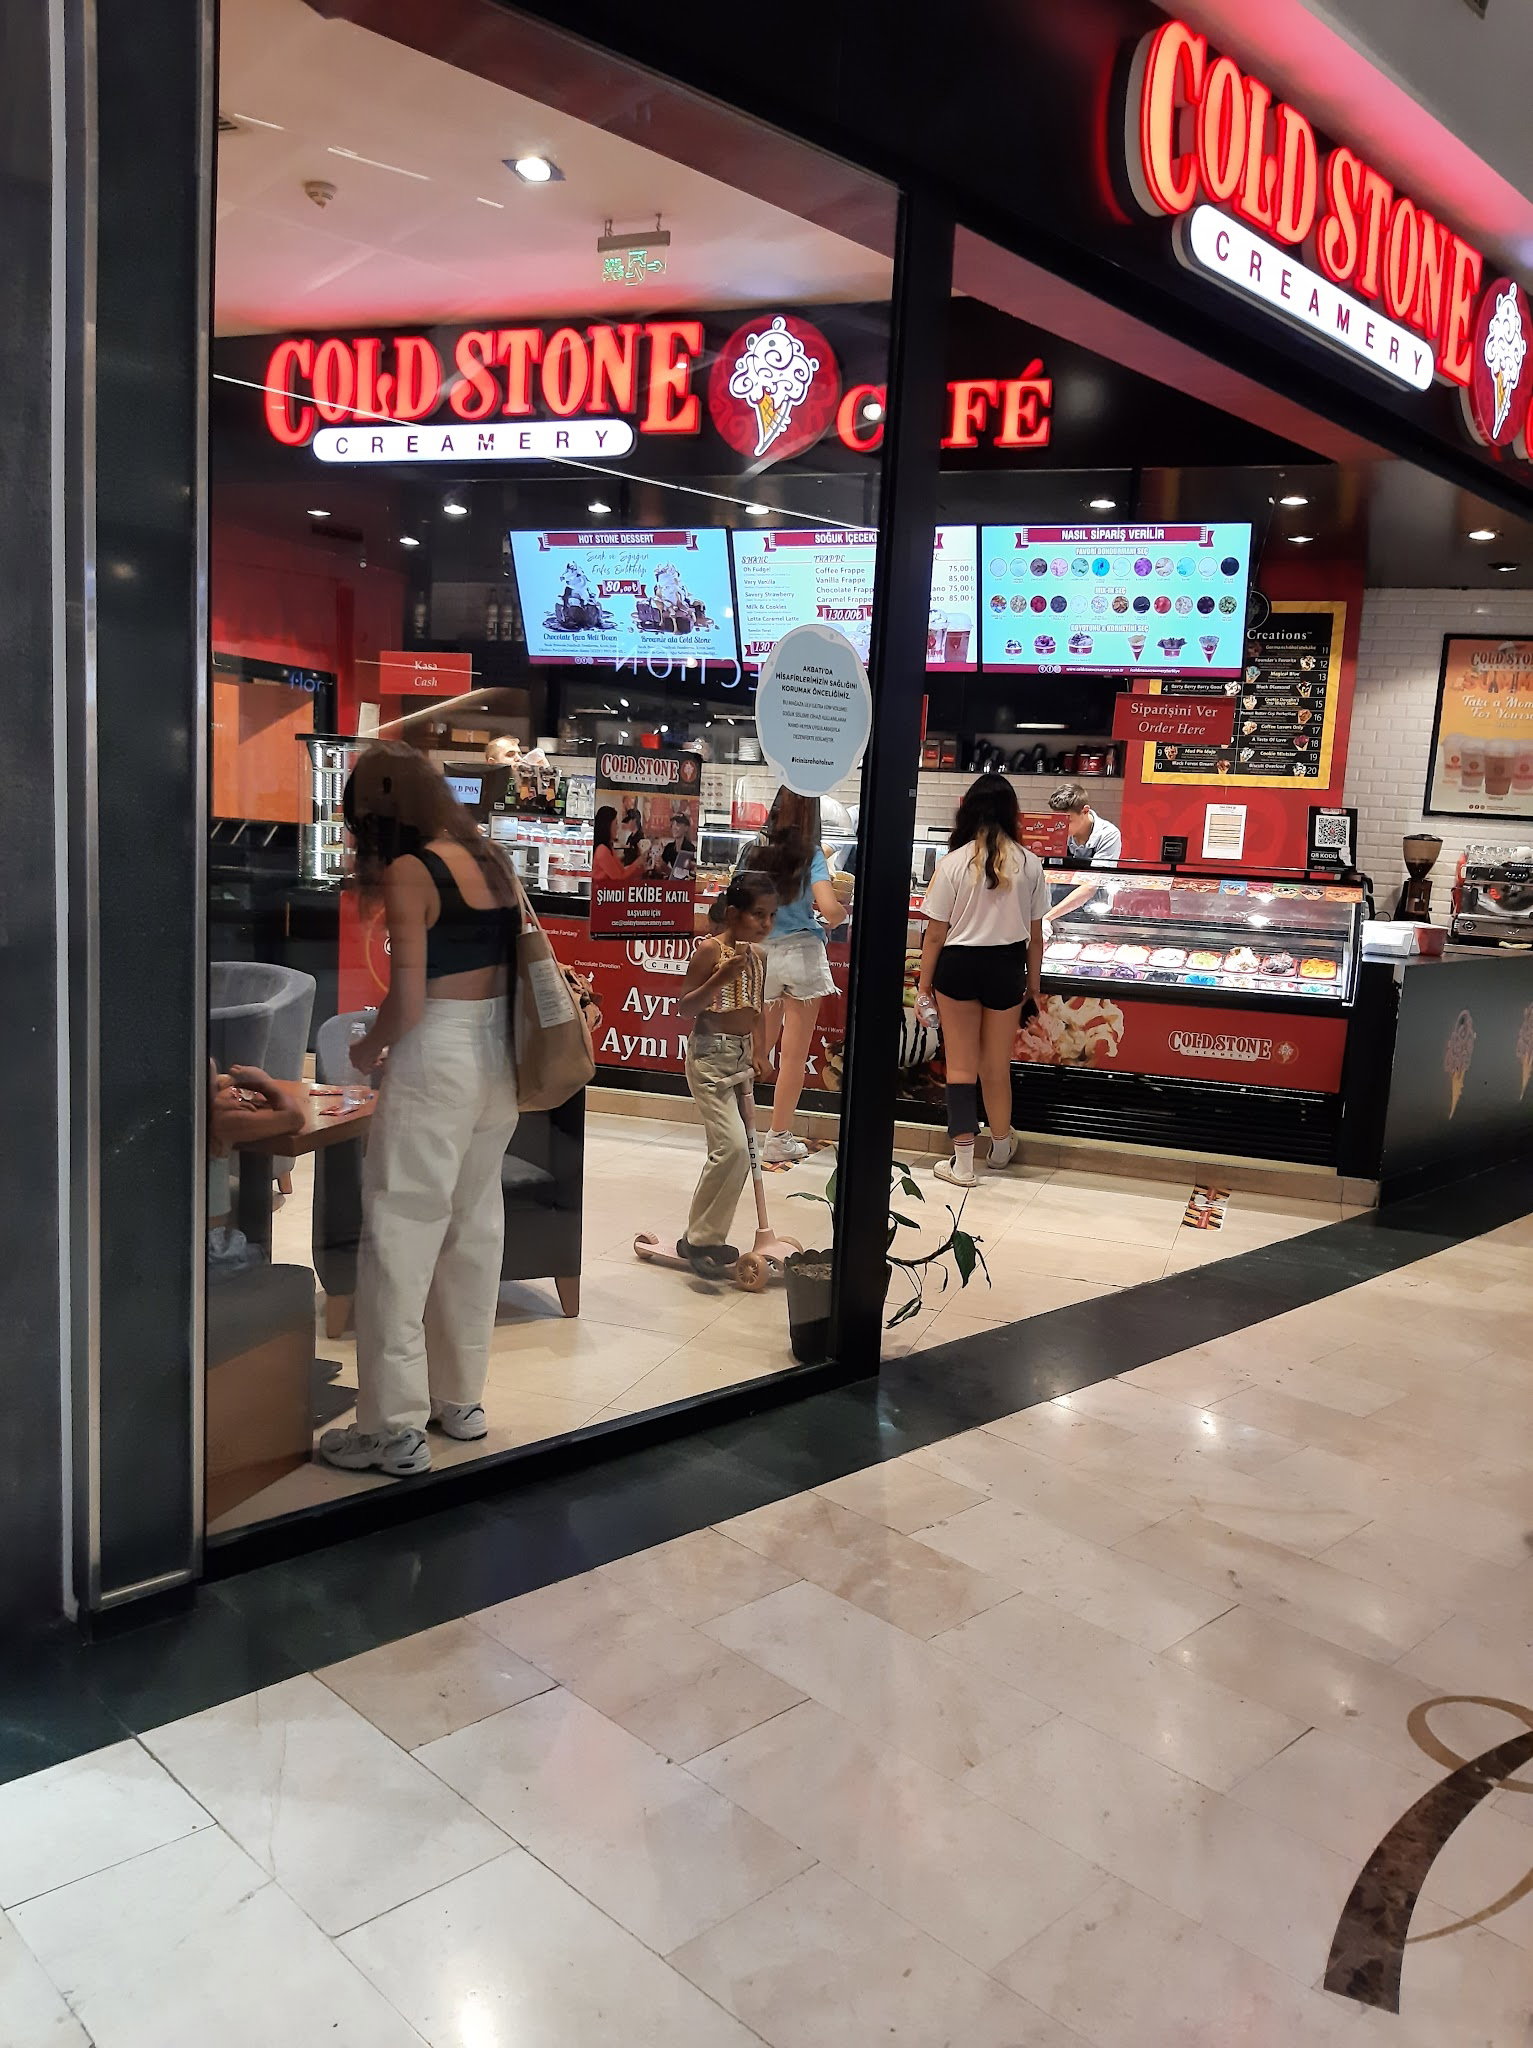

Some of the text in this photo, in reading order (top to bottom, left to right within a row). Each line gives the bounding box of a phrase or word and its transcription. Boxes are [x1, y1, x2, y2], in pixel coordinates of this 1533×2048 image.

[1140, 19, 1484, 388] COLD STONE
[1214, 230, 1423, 377] CREAMERY
[263, 321, 1053, 454] COLD STONE CFÉ
[335, 429, 612, 455] CREAMERY
[578, 535, 654, 544] HOT STONE DESSERT
[815, 532, 843, 543] SOĞUK
[1062, 529, 1164, 541] NASIL SİPARİŞ VERİLİR
[848, 596, 872, 604] Frappe
[414, 660, 438, 670] Kasa
[1471, 652, 1533, 666] COLD STO
[414, 677, 438, 687] Cash
[782, 685, 811, 694] KORUMAK
[1130, 703, 1218, 718] Siparişini Ver
[1138, 722, 1205, 735] Order Here
[601, 754, 679, 781] COLD STONE
[465, 786, 478, 794] POS
[597, 884, 690, 905] ŞİMDİ EKİBE KATIL
[600, 1027, 667, 1061] Aynı
[1169, 1031, 1271, 1059] COLD STONE
